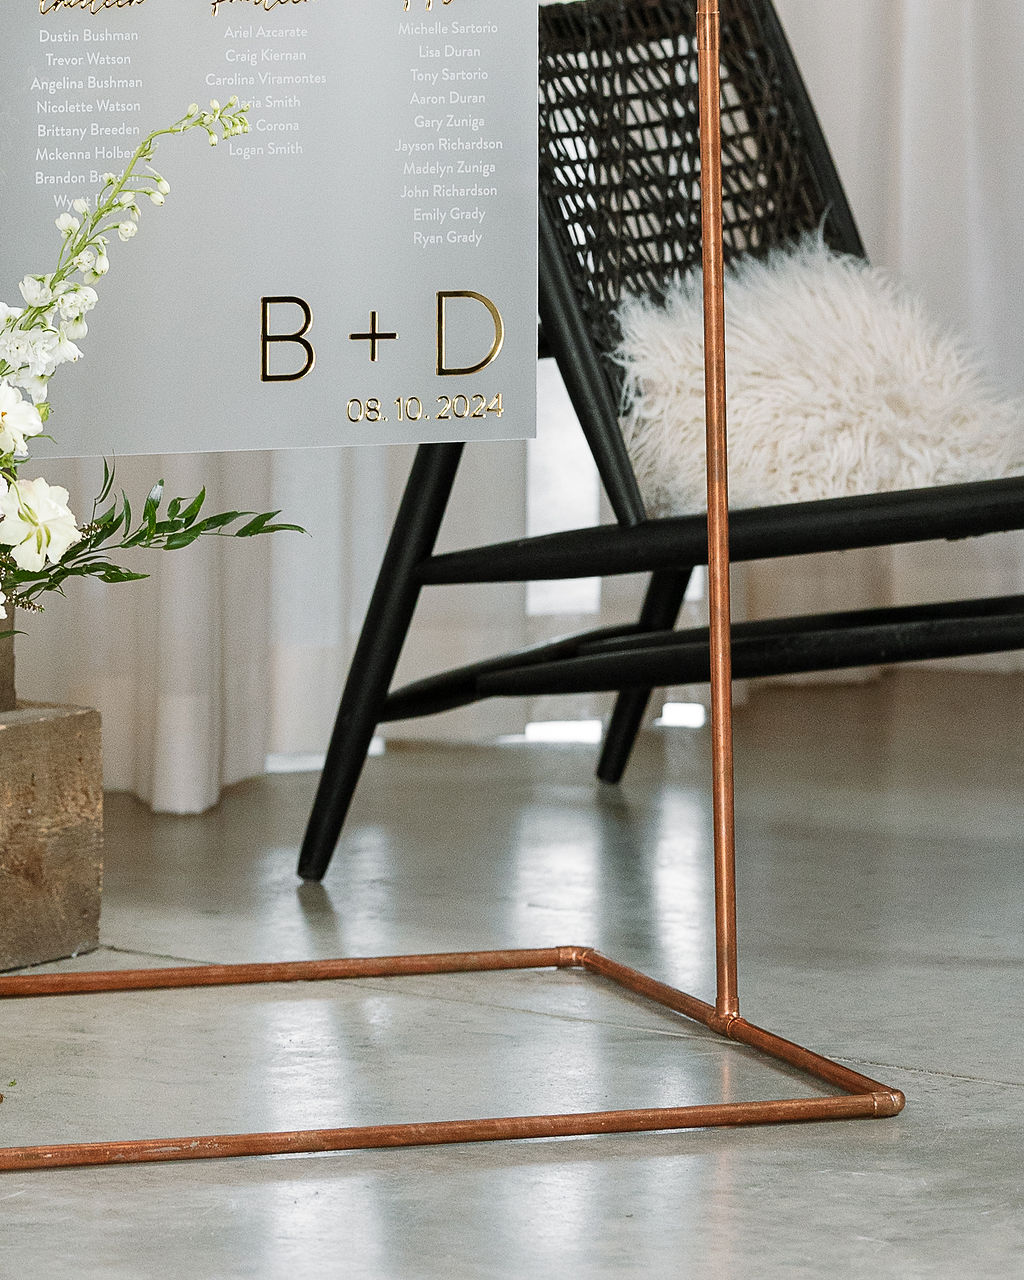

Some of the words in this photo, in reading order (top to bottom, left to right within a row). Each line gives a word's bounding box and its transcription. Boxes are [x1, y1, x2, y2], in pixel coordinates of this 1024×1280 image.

[223, 25, 253, 39] Ariel
[255, 25, 308, 38] Azcarate
[397, 21, 449, 35] Michelle
[451, 20, 499, 34] Sartorio
[39, 29, 80, 43] Dustin
[83, 28, 139, 42] Bushman
[45, 52, 84, 66] Trevor
[86, 51, 132, 65] Watson
[224, 48, 258, 67] Craig
[260, 48, 307, 62] Kiernan
[418, 45, 441, 58] Lisa
[444, 44, 481, 58] Duran
[204, 72, 255, 86] Carolina
[257, 71, 327, 85] Viramontes
[409, 91, 446, 105] Aaron
[449, 90, 486, 104] Duran
[36, 100, 94, 114] Nicolette
[96, 99, 141, 112] Watson
[37, 123, 87, 141] Brittany
[90, 122, 140, 136] Breeden
[394, 139, 435, 156] Jayson
[438, 136, 504, 151] Richardson
[403, 161, 454, 179] Madelyn
[456, 160, 496, 178] Zuniga
[413, 207, 447, 225] Emily
[449, 206, 486, 224] Grady
[261, 296, 314, 381] B
[436, 291, 504, 375] D
